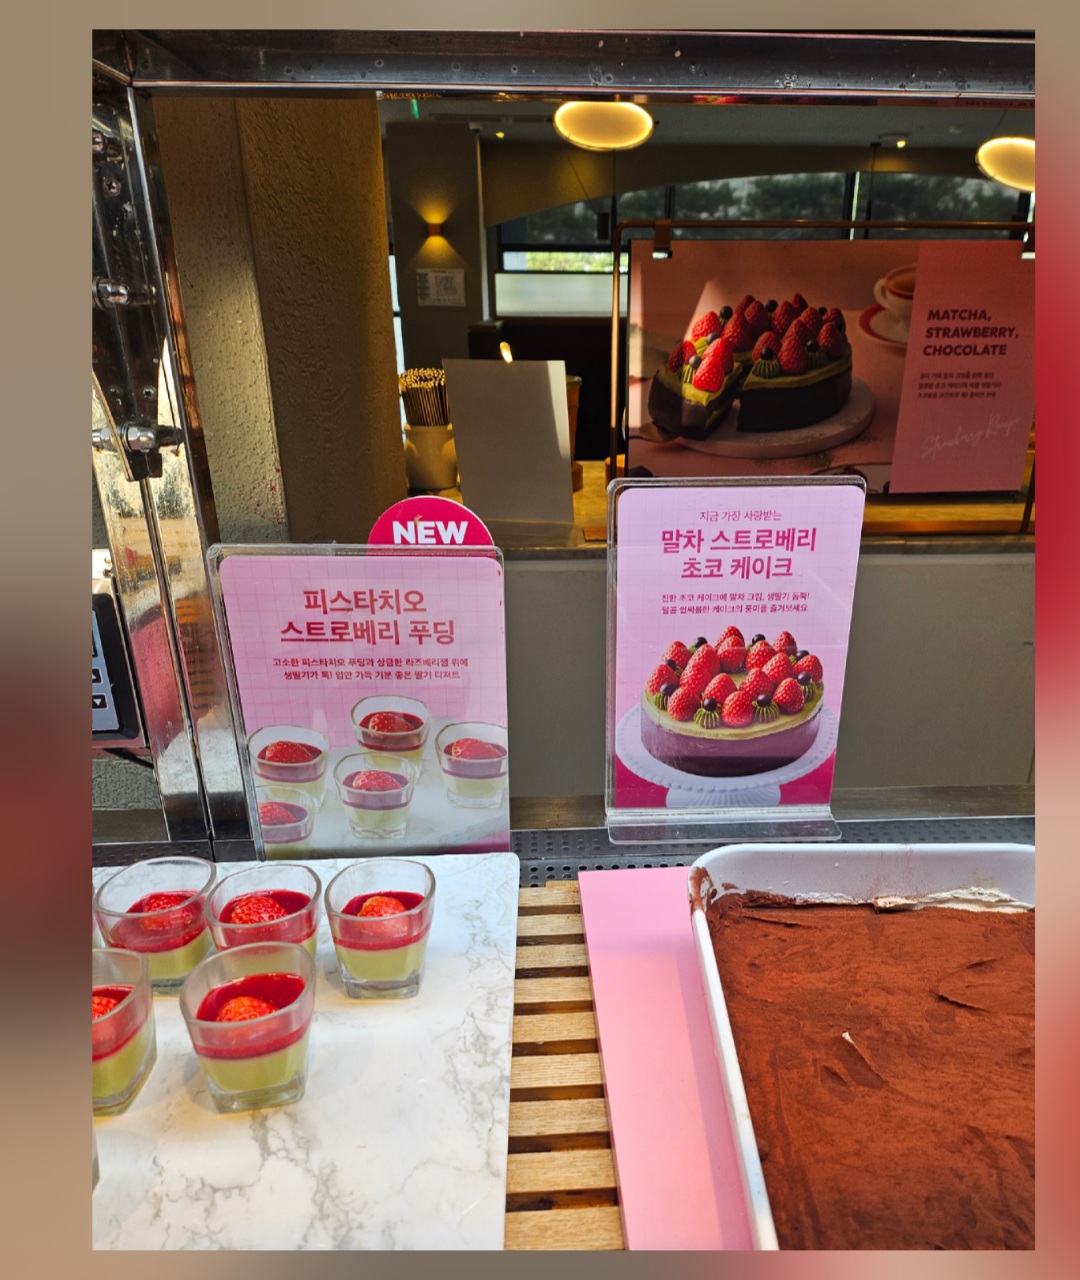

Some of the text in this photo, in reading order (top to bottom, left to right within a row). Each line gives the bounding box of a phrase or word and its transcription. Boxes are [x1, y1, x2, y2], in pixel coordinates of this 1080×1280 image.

[927, 309, 992, 321] MATCHA,
[925, 326, 1019, 339] STRAWBERRY,
[923, 344, 1008, 356] CHOCOLATE
[700, 510, 782, 522] 지금 가장 사랑받는
[392, 520, 468, 544] NEW
[661, 527, 817, 554] 말차 스트로베리
[681, 556, 793, 579] 초코 케이크
[303, 588, 427, 615] 피스타치오
[281, 619, 455, 645] 스트로베리 푸딩
[273, 658, 299, 667] 고소한
[301, 658, 346, 667] 피스타치오
[349, 658, 375, 667] 푸딩과
[405, 658, 449, 667] 라즈베리잼
[451, 658, 469, 667] 위에
[283, 671, 319, 680] 생딸기가
[335, 671, 353, 680] 입안
[355, 671, 373, 680] 가득
[375, 671, 392, 680] 기분
[415, 671, 432, 680] 딸기
[434, 671, 461, 680] 디저트
